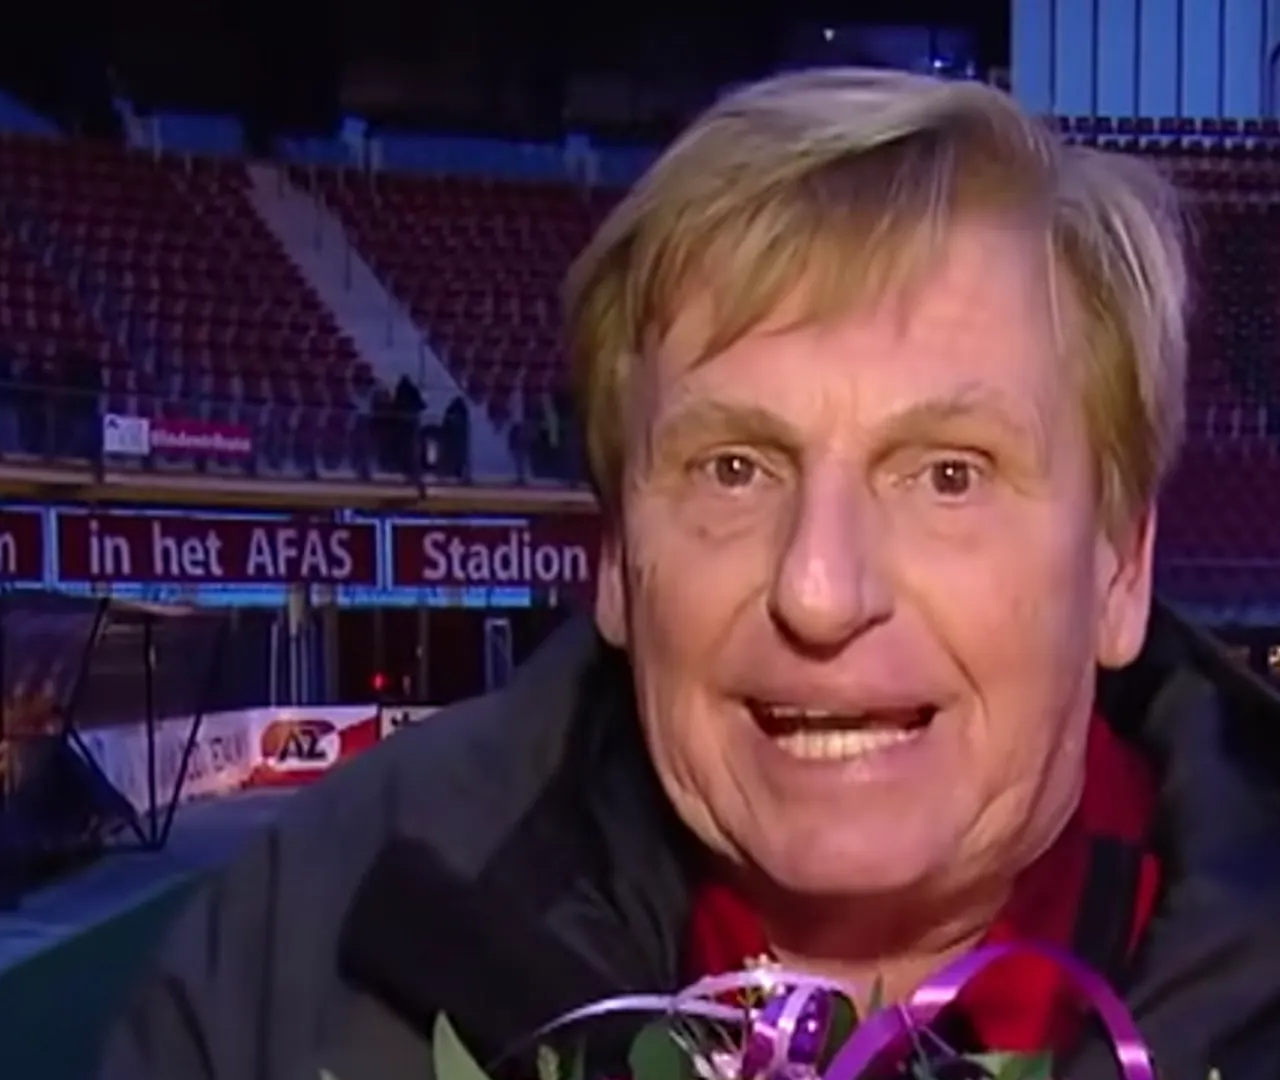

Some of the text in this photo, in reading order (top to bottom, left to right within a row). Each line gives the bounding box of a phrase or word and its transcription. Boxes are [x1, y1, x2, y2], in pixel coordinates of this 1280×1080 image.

[89, 520, 131, 577] in
[153, 520, 224, 577] het
[246, 527, 353, 578] AFAS
[423, 530, 590, 582] Stadion
[278, 727, 328, 763] AZ
